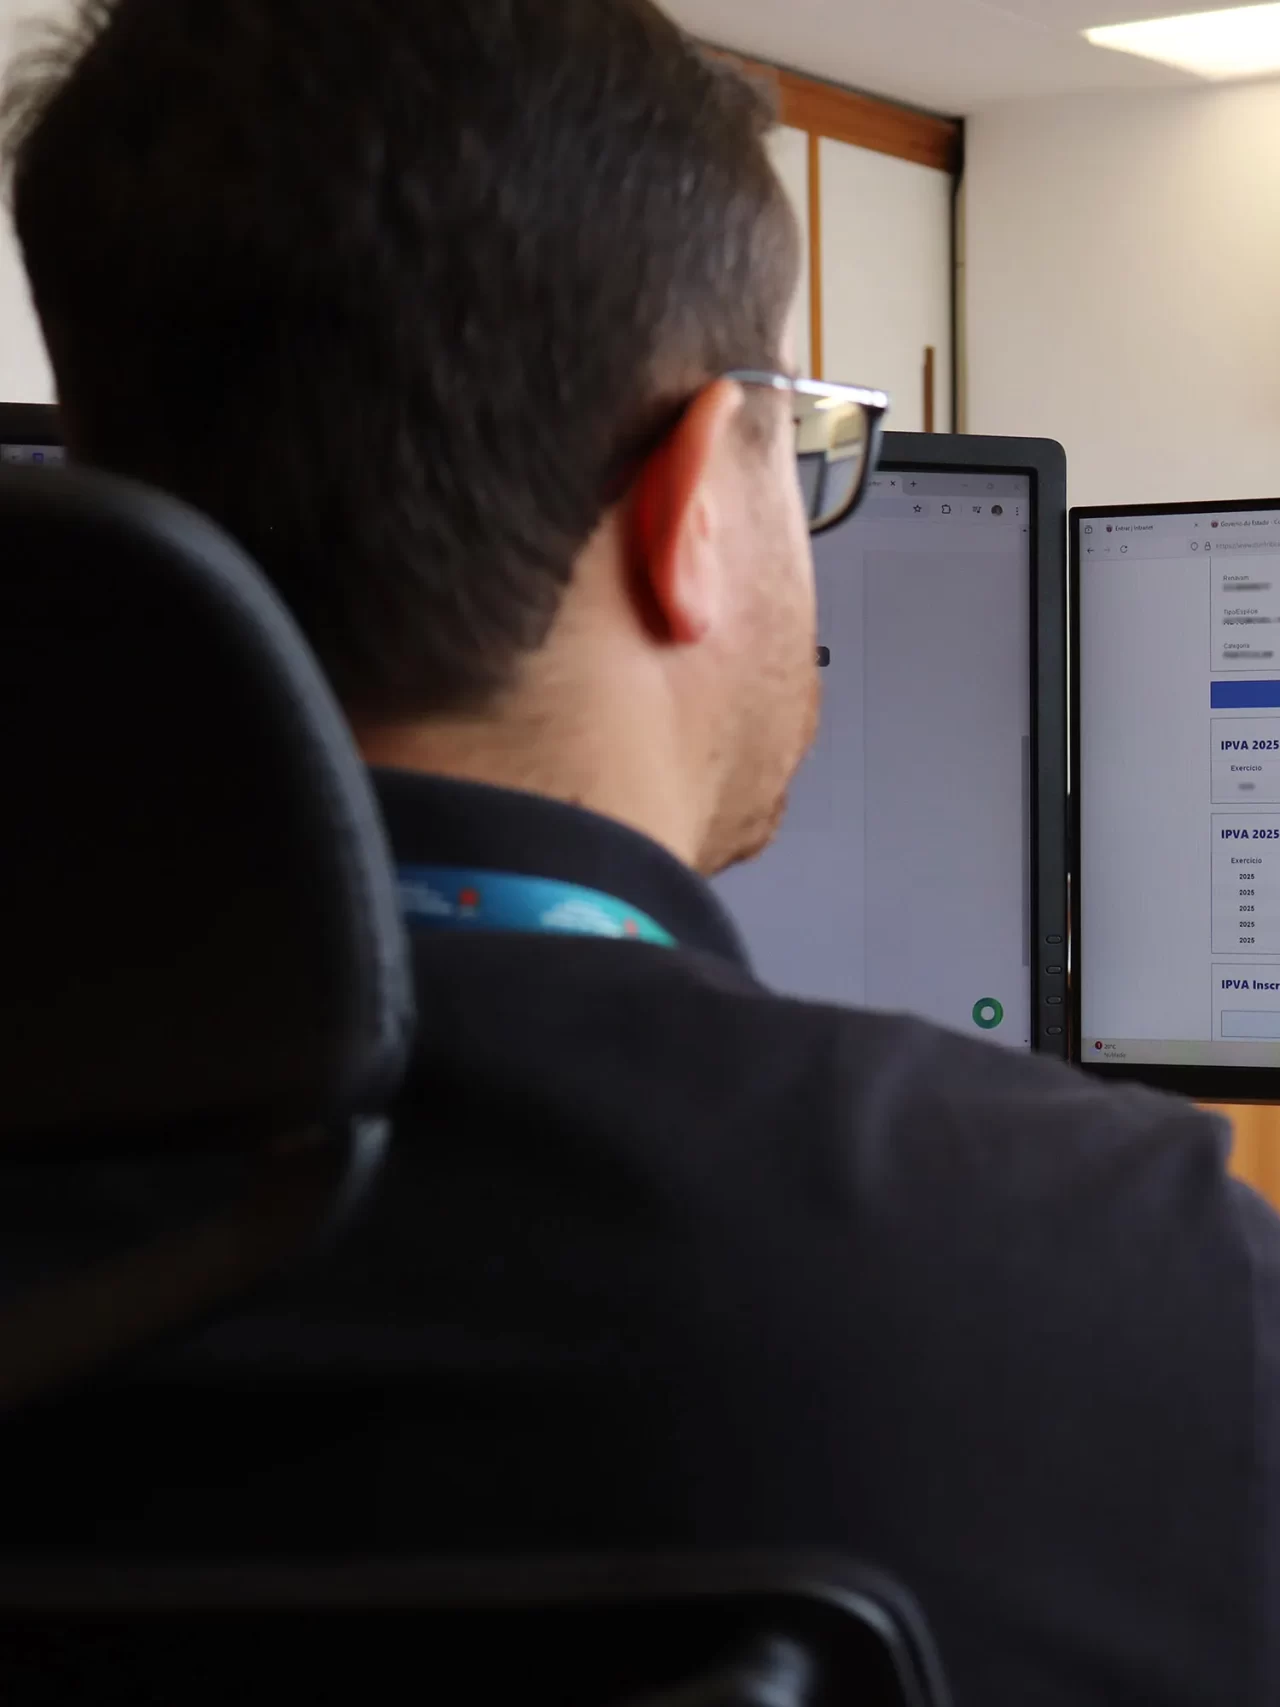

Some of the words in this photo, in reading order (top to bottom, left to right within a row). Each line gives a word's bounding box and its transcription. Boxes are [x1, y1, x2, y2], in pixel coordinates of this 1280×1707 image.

[1221, 740, 1249, 751] IPVA
[1252, 740, 1280, 751] 2025
[1221, 829, 1249, 840] IPVA
[1252, 829, 1280, 840] 2025
[1239, 873, 1255, 881] 2025
[1239, 889, 1255, 897] 2025
[1239, 905, 1255, 913] 2025
[1239, 921, 1255, 929] 2025
[1239, 937, 1255, 945] 2025
[1221, 980, 1249, 990] IPVA
